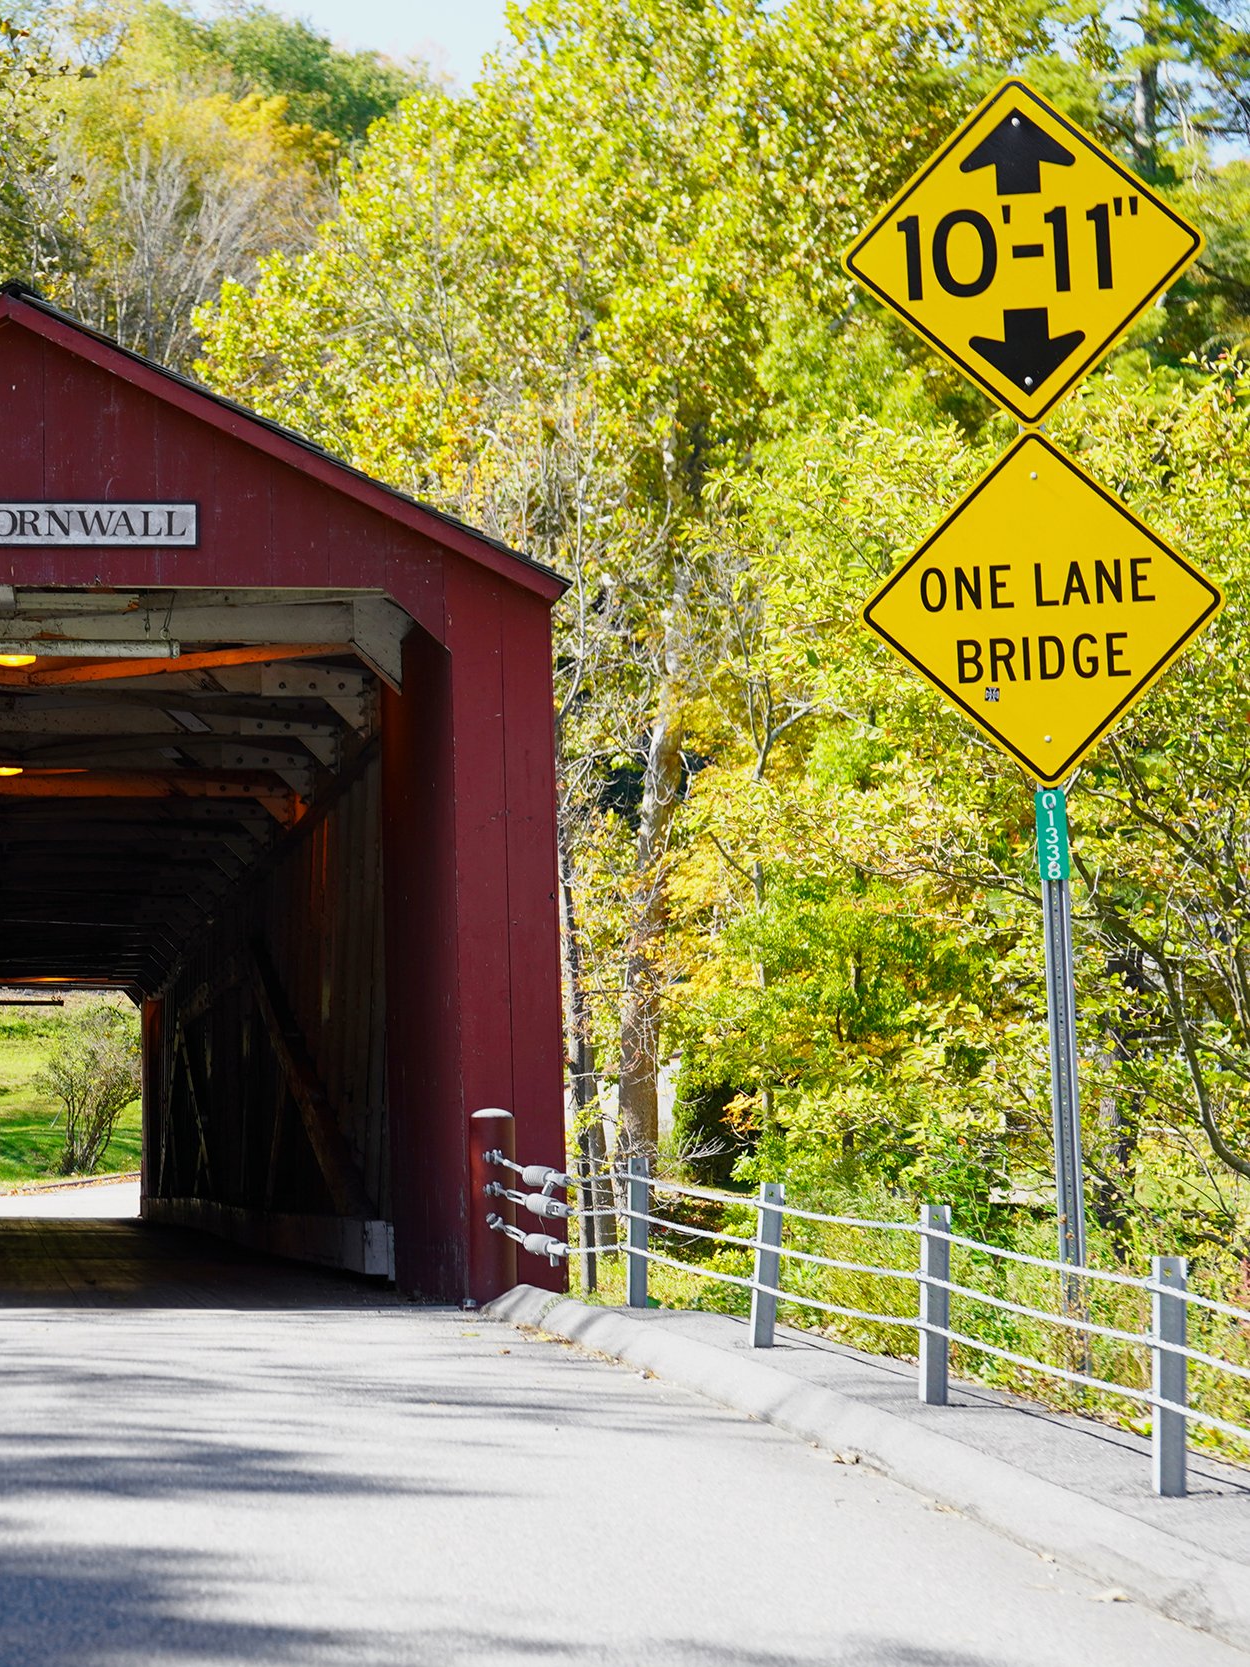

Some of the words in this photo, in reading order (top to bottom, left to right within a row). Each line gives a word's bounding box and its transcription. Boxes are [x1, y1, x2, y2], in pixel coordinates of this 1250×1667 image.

[920, 564, 1015, 613] ONE
[1034, 557, 1156, 607] LANE
[956, 632, 1132, 684] BRIDGE
[1041, 792, 1062, 880] 01338
